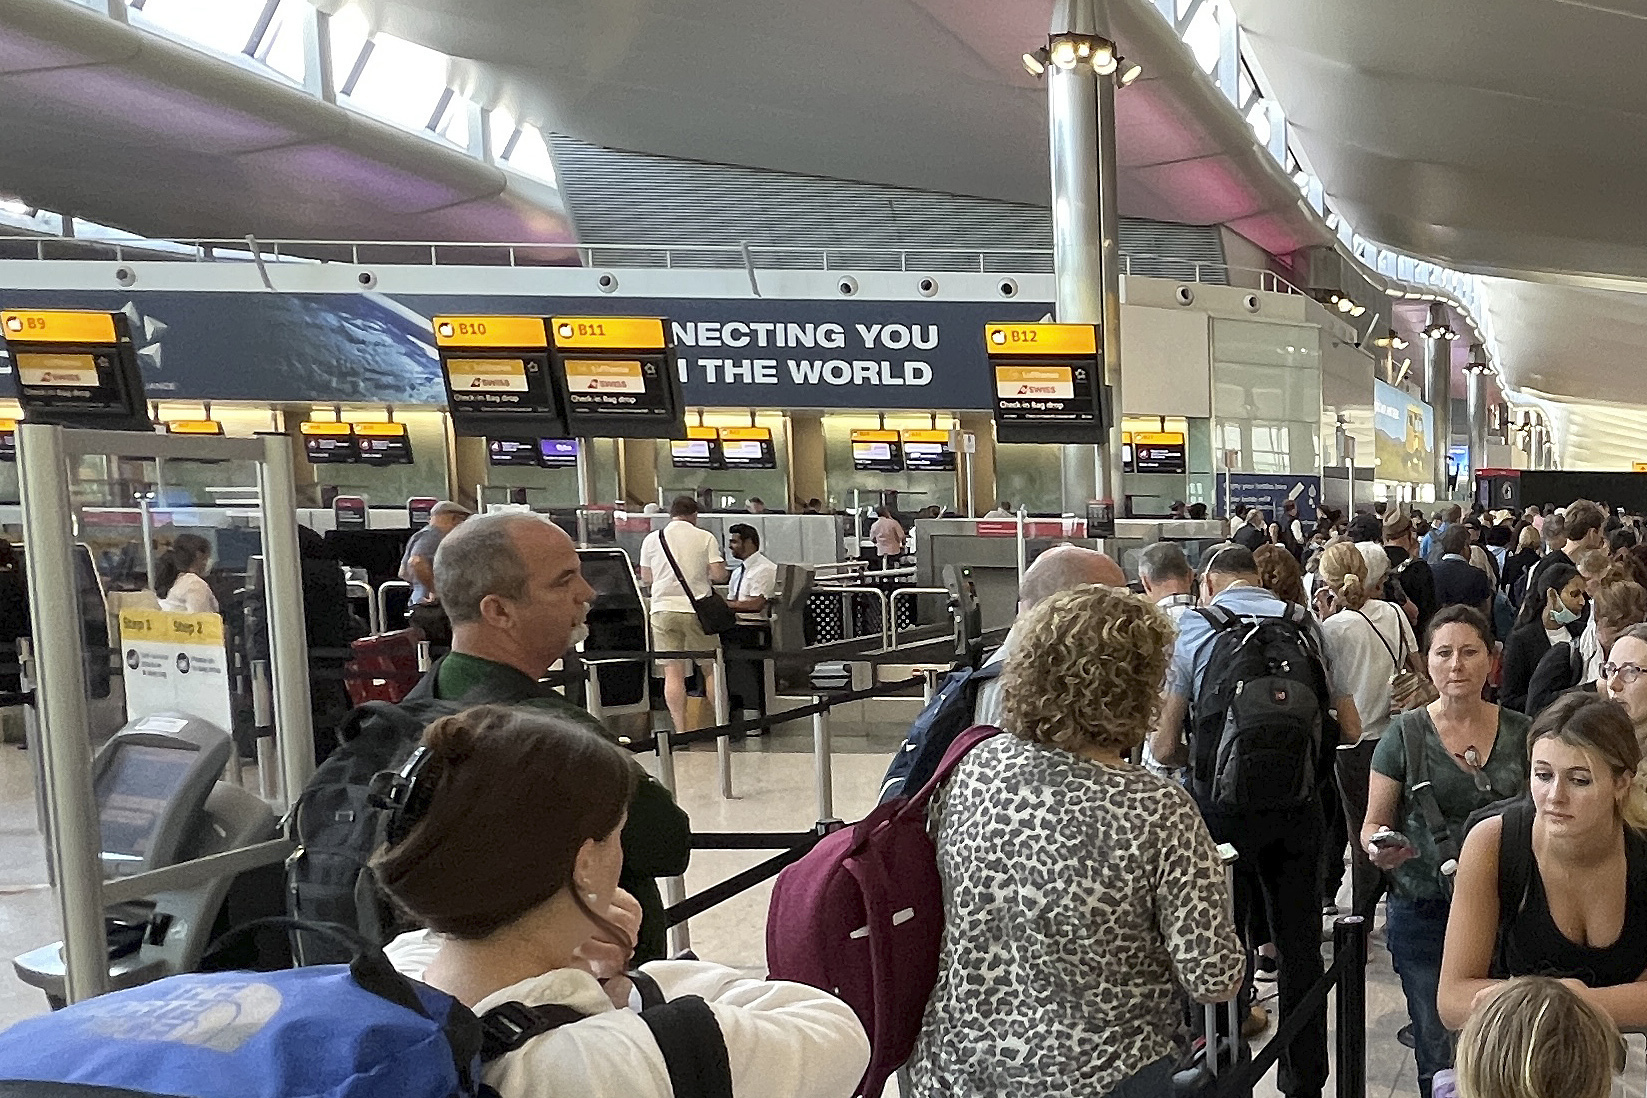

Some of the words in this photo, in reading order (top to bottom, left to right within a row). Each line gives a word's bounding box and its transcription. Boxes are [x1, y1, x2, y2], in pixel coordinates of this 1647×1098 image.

[27, 318, 46, 329] B9
[459, 324, 487, 335] B10
[578, 324, 606, 336] B11
[671, 321, 846, 348] NECTING
[855, 323, 939, 350] YOU
[1011, 330, 1038, 342] B12
[697, 357, 778, 384] THE
[787, 359, 933, 386] WORLD
